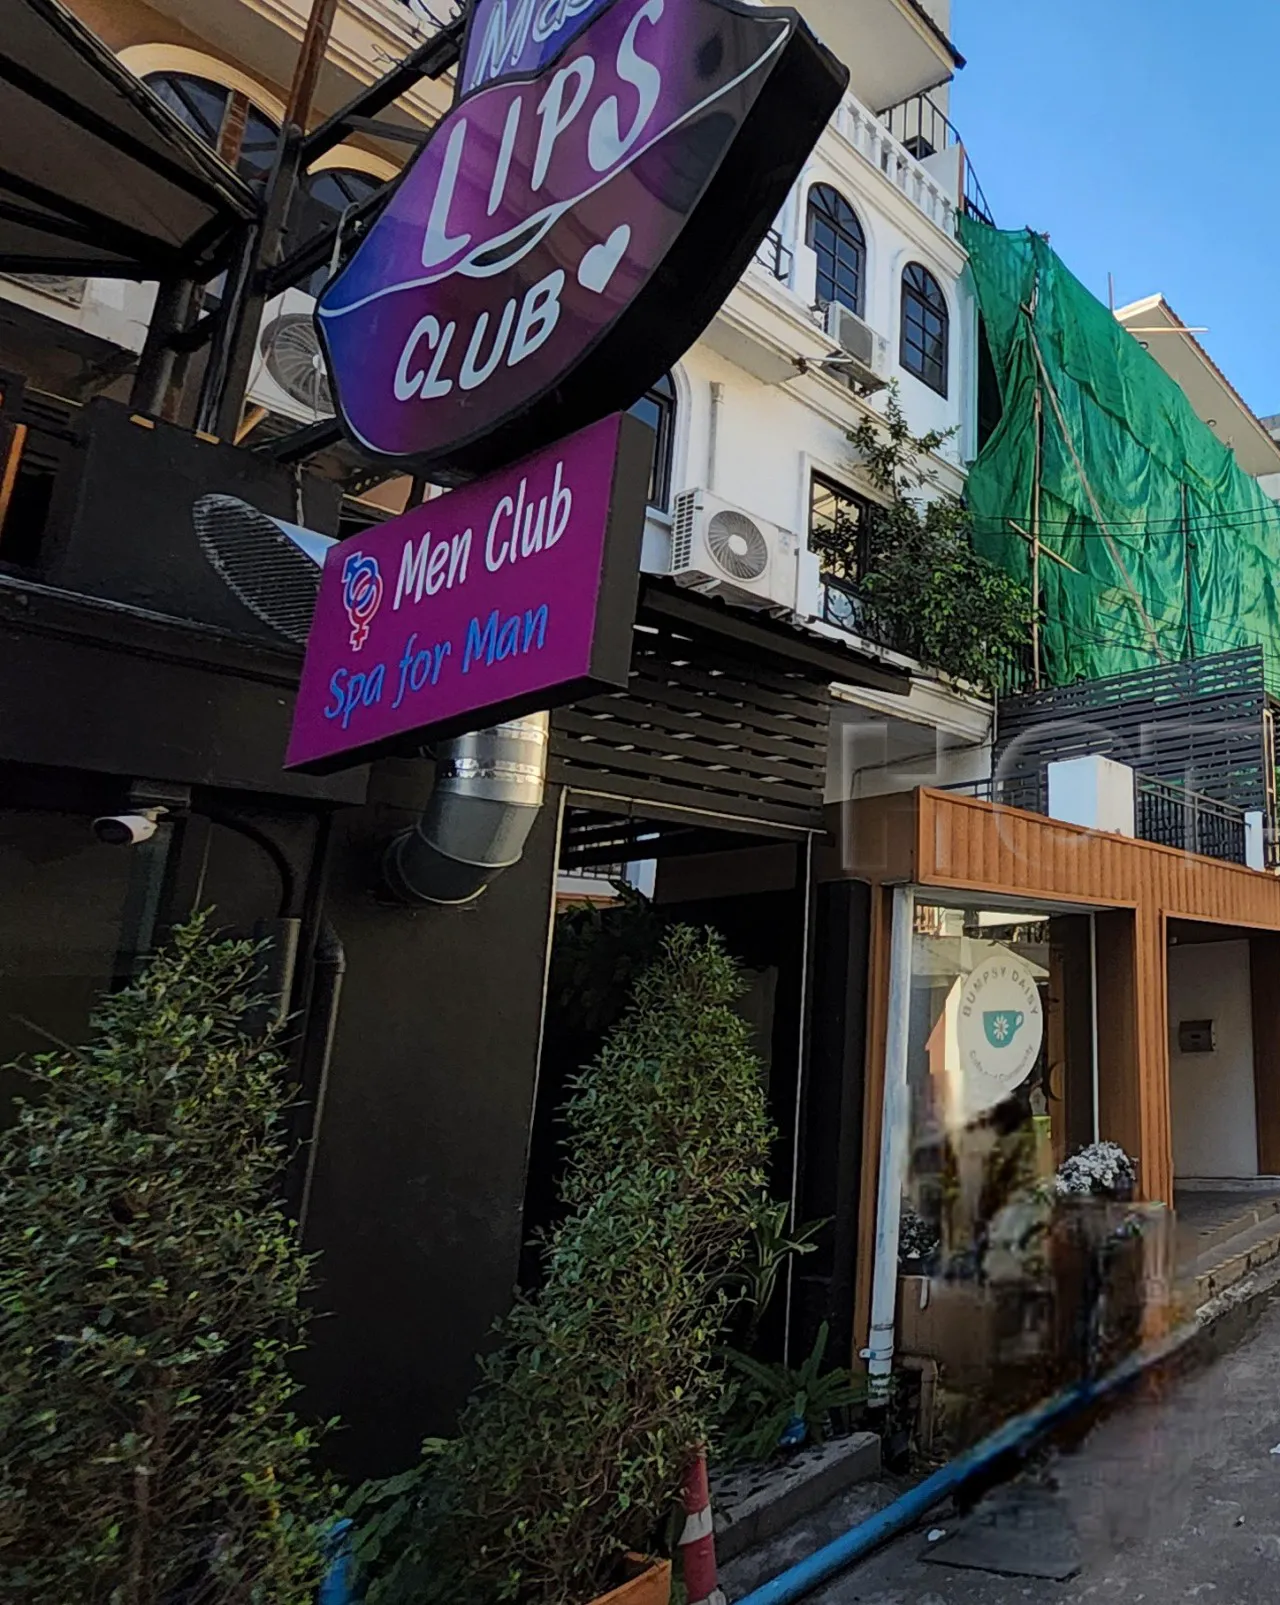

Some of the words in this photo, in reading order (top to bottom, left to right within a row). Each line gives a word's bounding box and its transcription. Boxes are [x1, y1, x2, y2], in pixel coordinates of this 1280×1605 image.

[421, 0, 664, 267] LIPS
[393, 269, 565, 401] CLUB
[393, 528, 473, 610] Men
[485, 461, 572, 572] Club
[324, 663, 386, 728] Spa
[392, 633, 451, 708] for
[462, 603, 549, 673] Man
